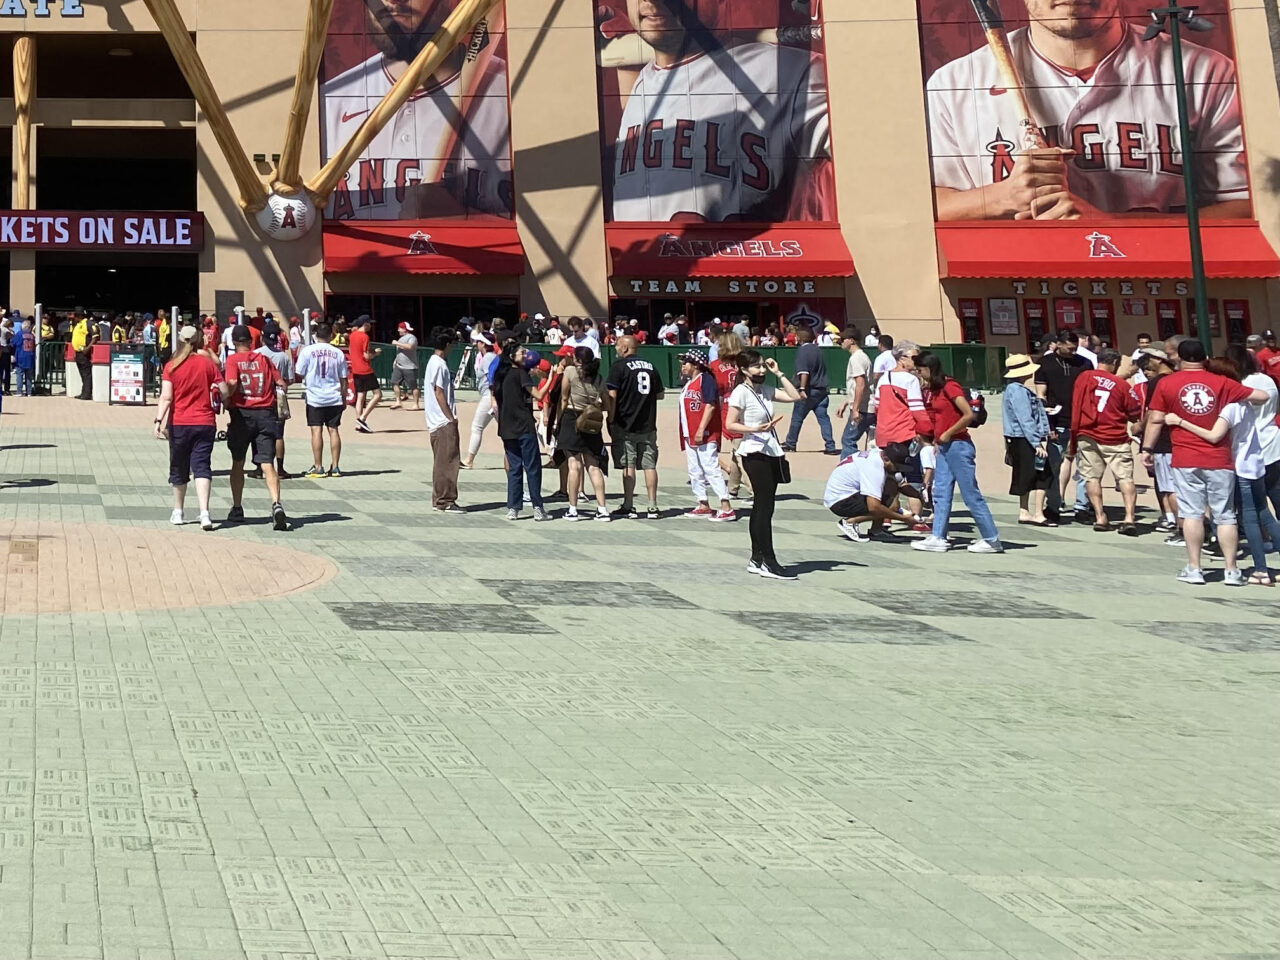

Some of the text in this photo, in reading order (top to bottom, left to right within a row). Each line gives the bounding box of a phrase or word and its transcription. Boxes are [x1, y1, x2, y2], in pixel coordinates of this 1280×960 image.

[79, 218, 114, 244] ON
[124, 218, 191, 244] SALE
[658, 232, 803, 258] ANGELS
[631, 280, 816, 293] TEAM STORE
[1013, 281, 1188, 296] TICKETS
[239, 372, 264, 394] 27
[636, 371, 651, 395] 8
[1094, 389, 1111, 413] 7
